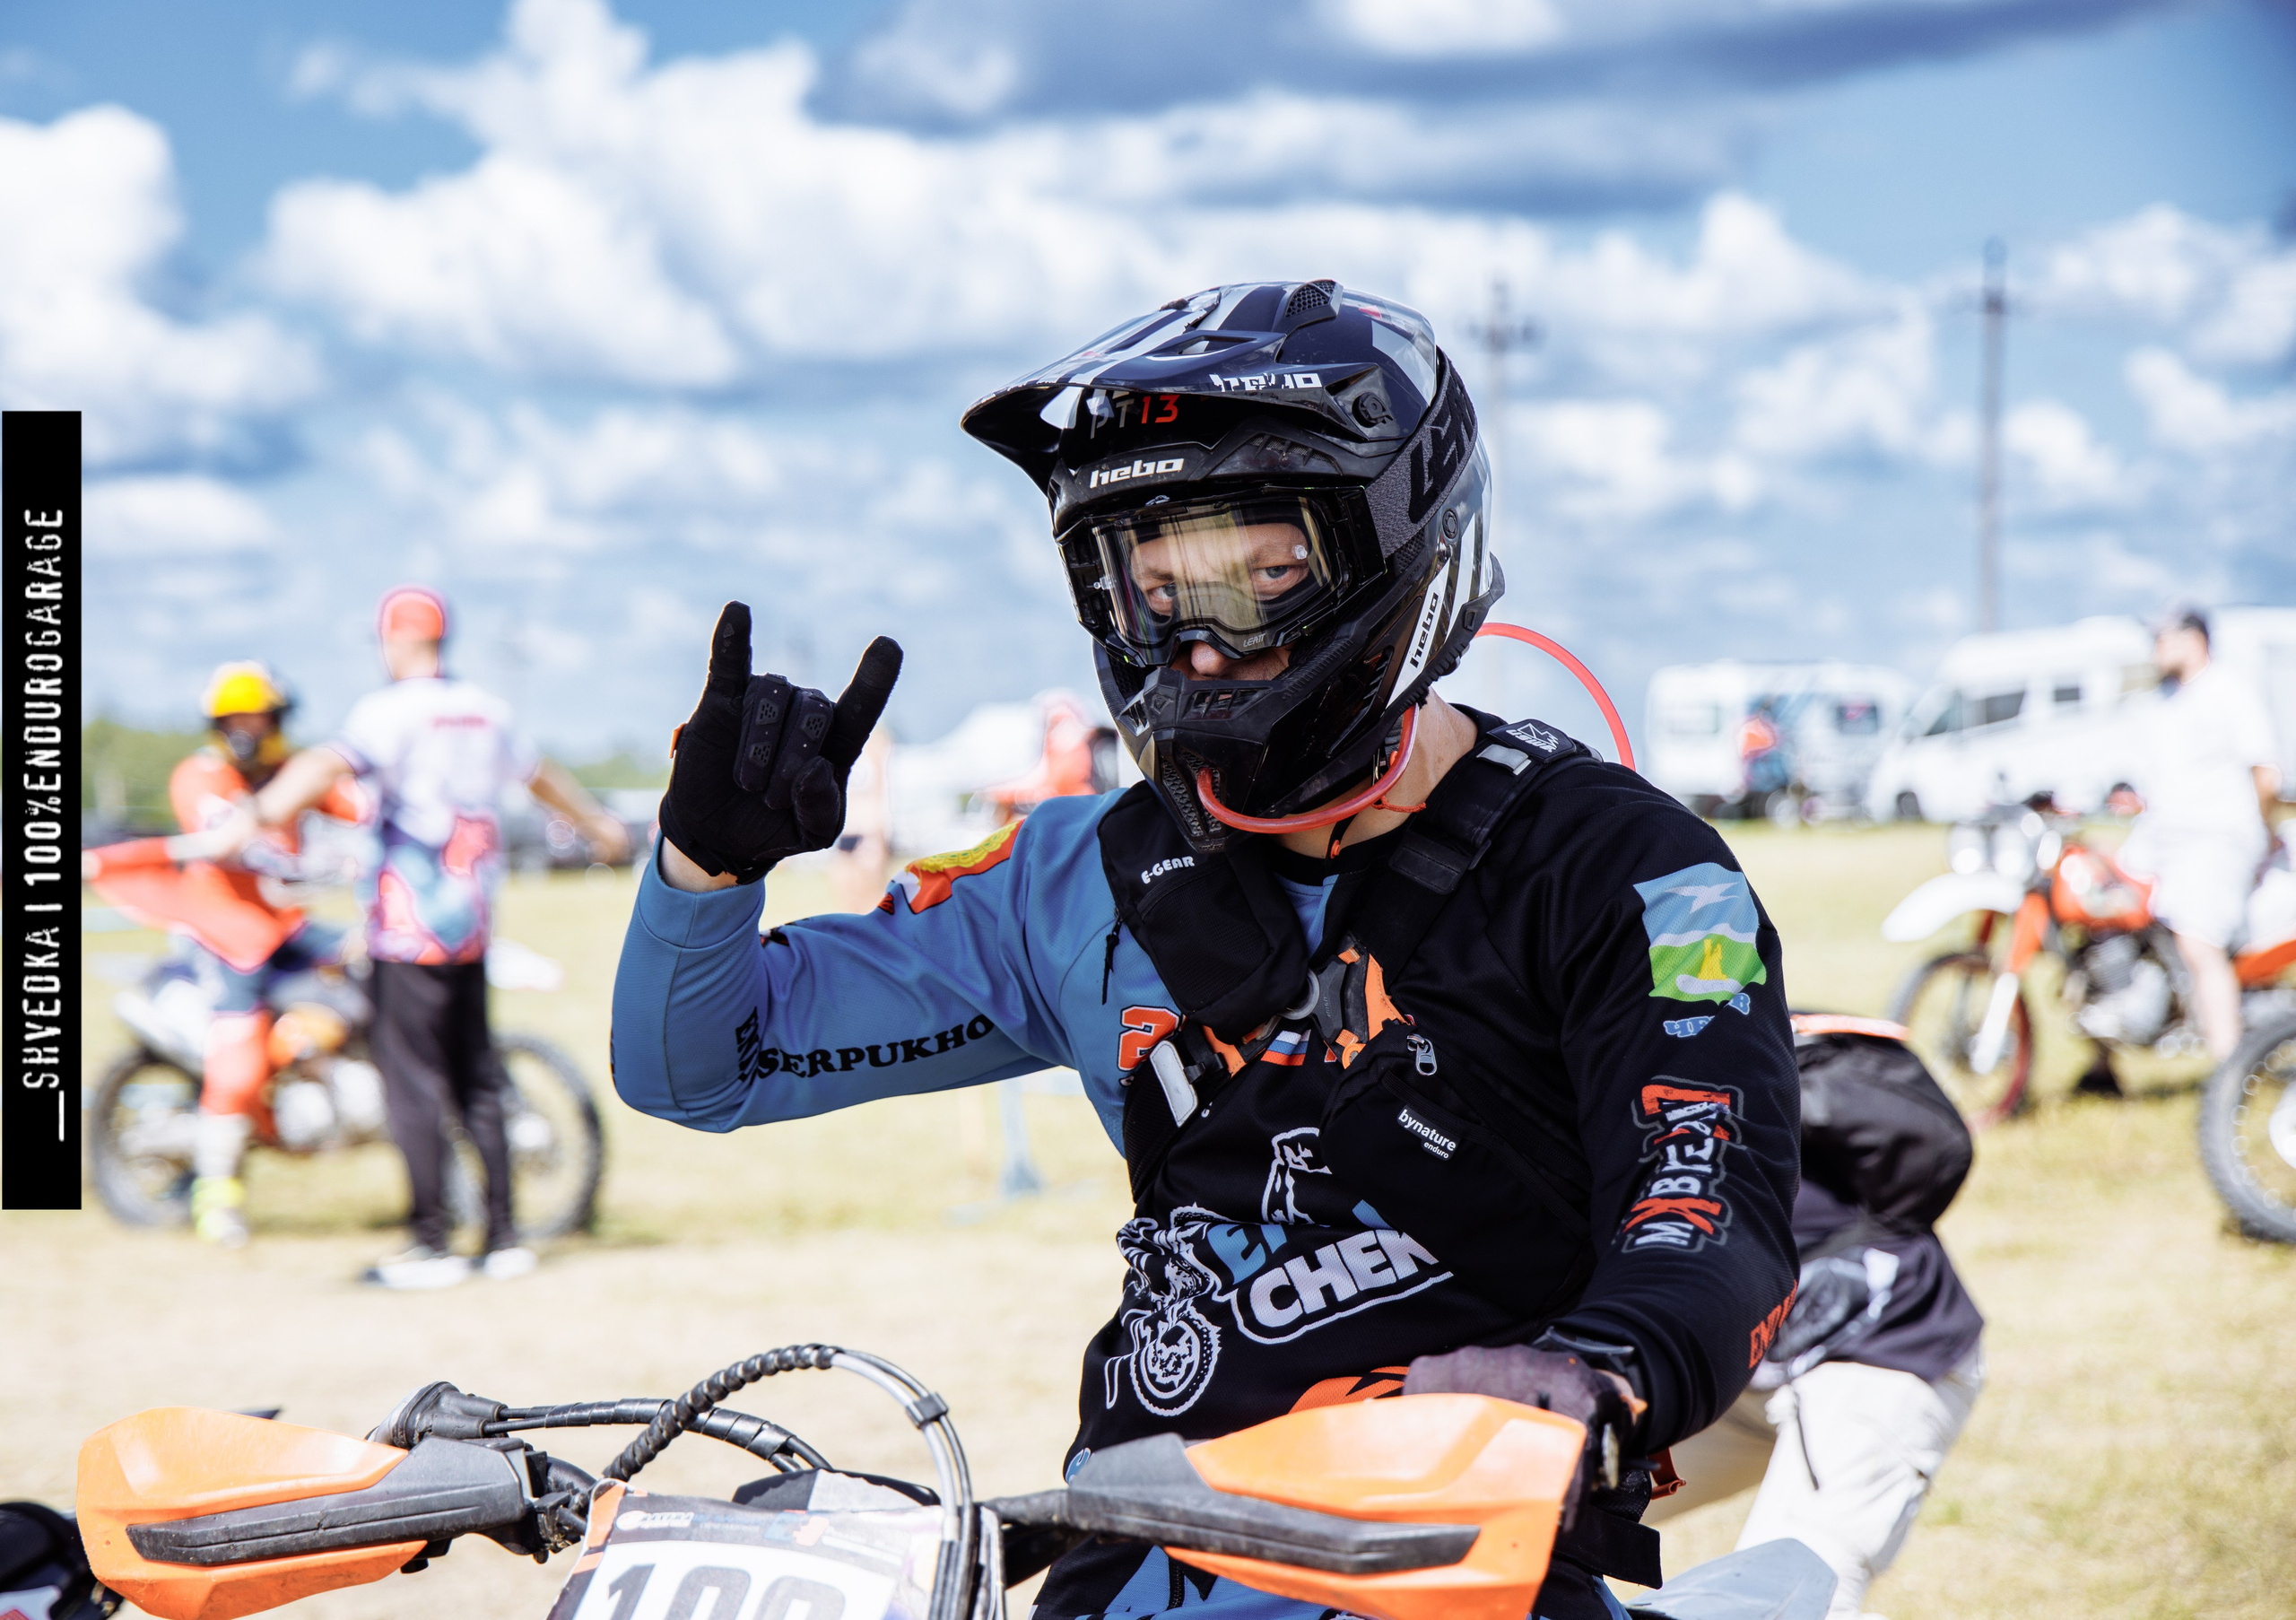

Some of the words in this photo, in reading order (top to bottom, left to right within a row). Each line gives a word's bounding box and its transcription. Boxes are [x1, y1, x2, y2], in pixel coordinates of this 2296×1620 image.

[1090, 458, 1184, 489] hebo
[1242, 632, 1266, 648] LEATT
[1410, 592, 1439, 668] hebo
[1141, 856, 1195, 884] E-GEAR
[1398, 1109, 1457, 1151] bynature
[1423, 1142, 1449, 1159] enduro
